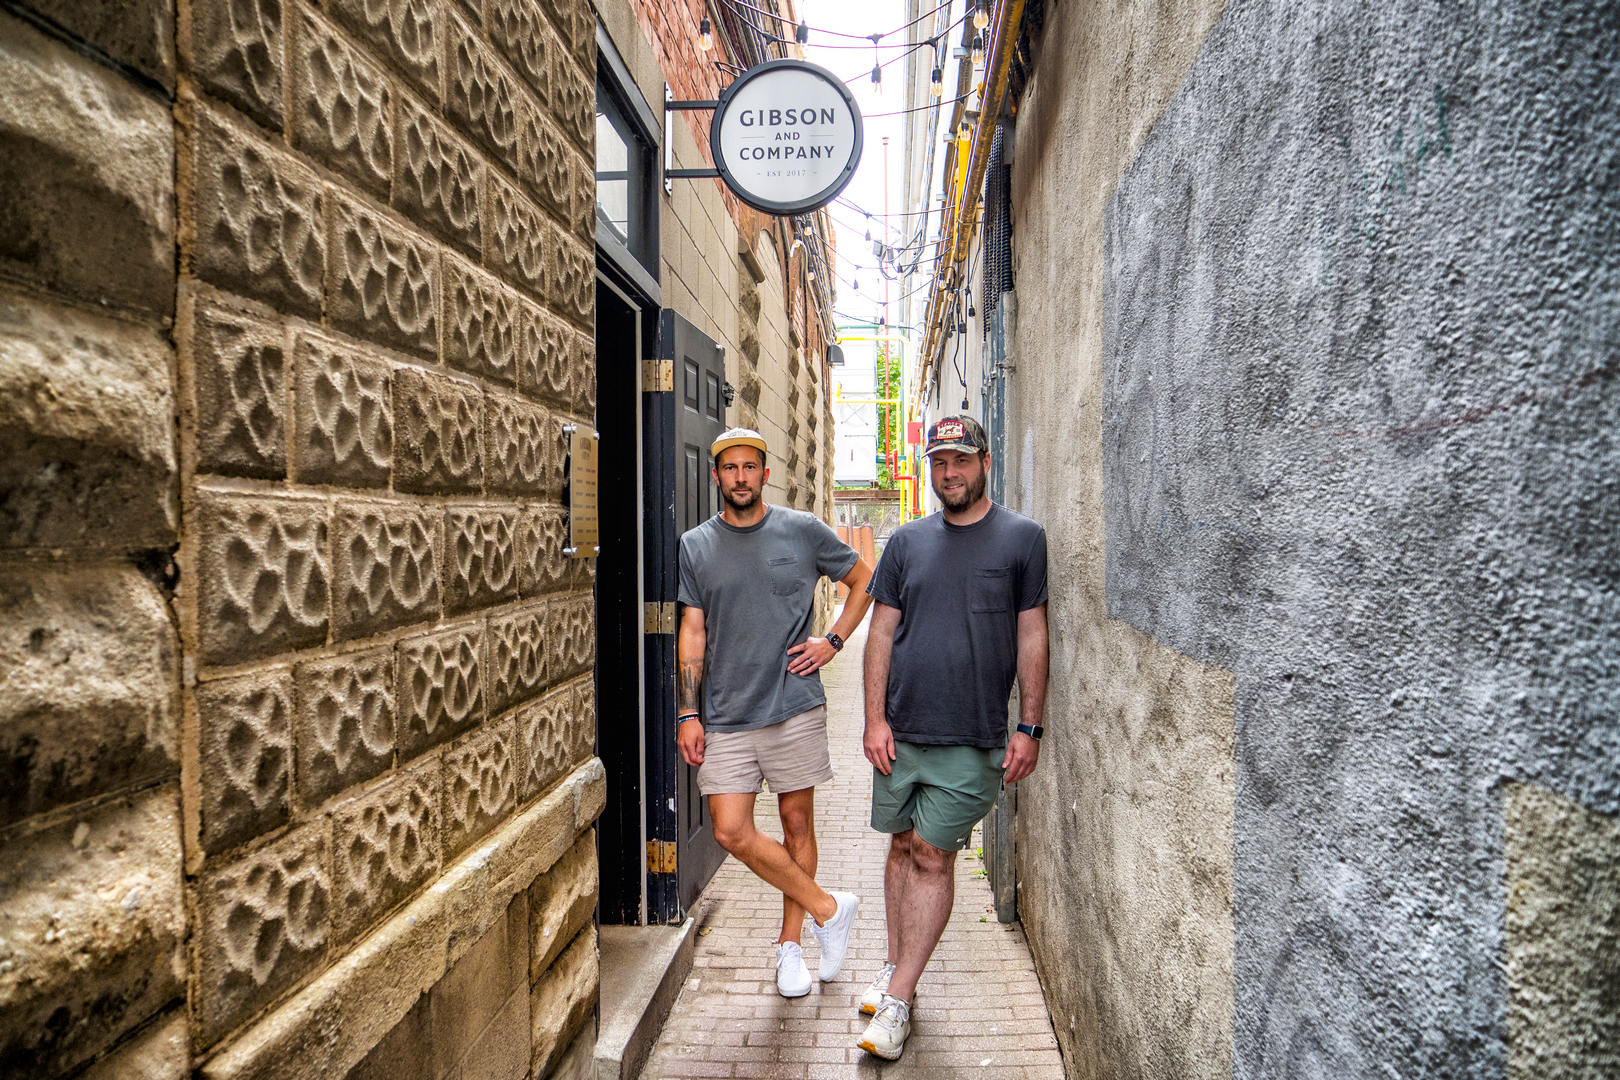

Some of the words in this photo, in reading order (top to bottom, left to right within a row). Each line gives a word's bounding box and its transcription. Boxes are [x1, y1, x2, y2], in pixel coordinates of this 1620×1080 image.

[740, 108, 835, 127] GIBSON
[775, 132, 800, 140] AND
[740, 146, 835, 160] COMPANY
